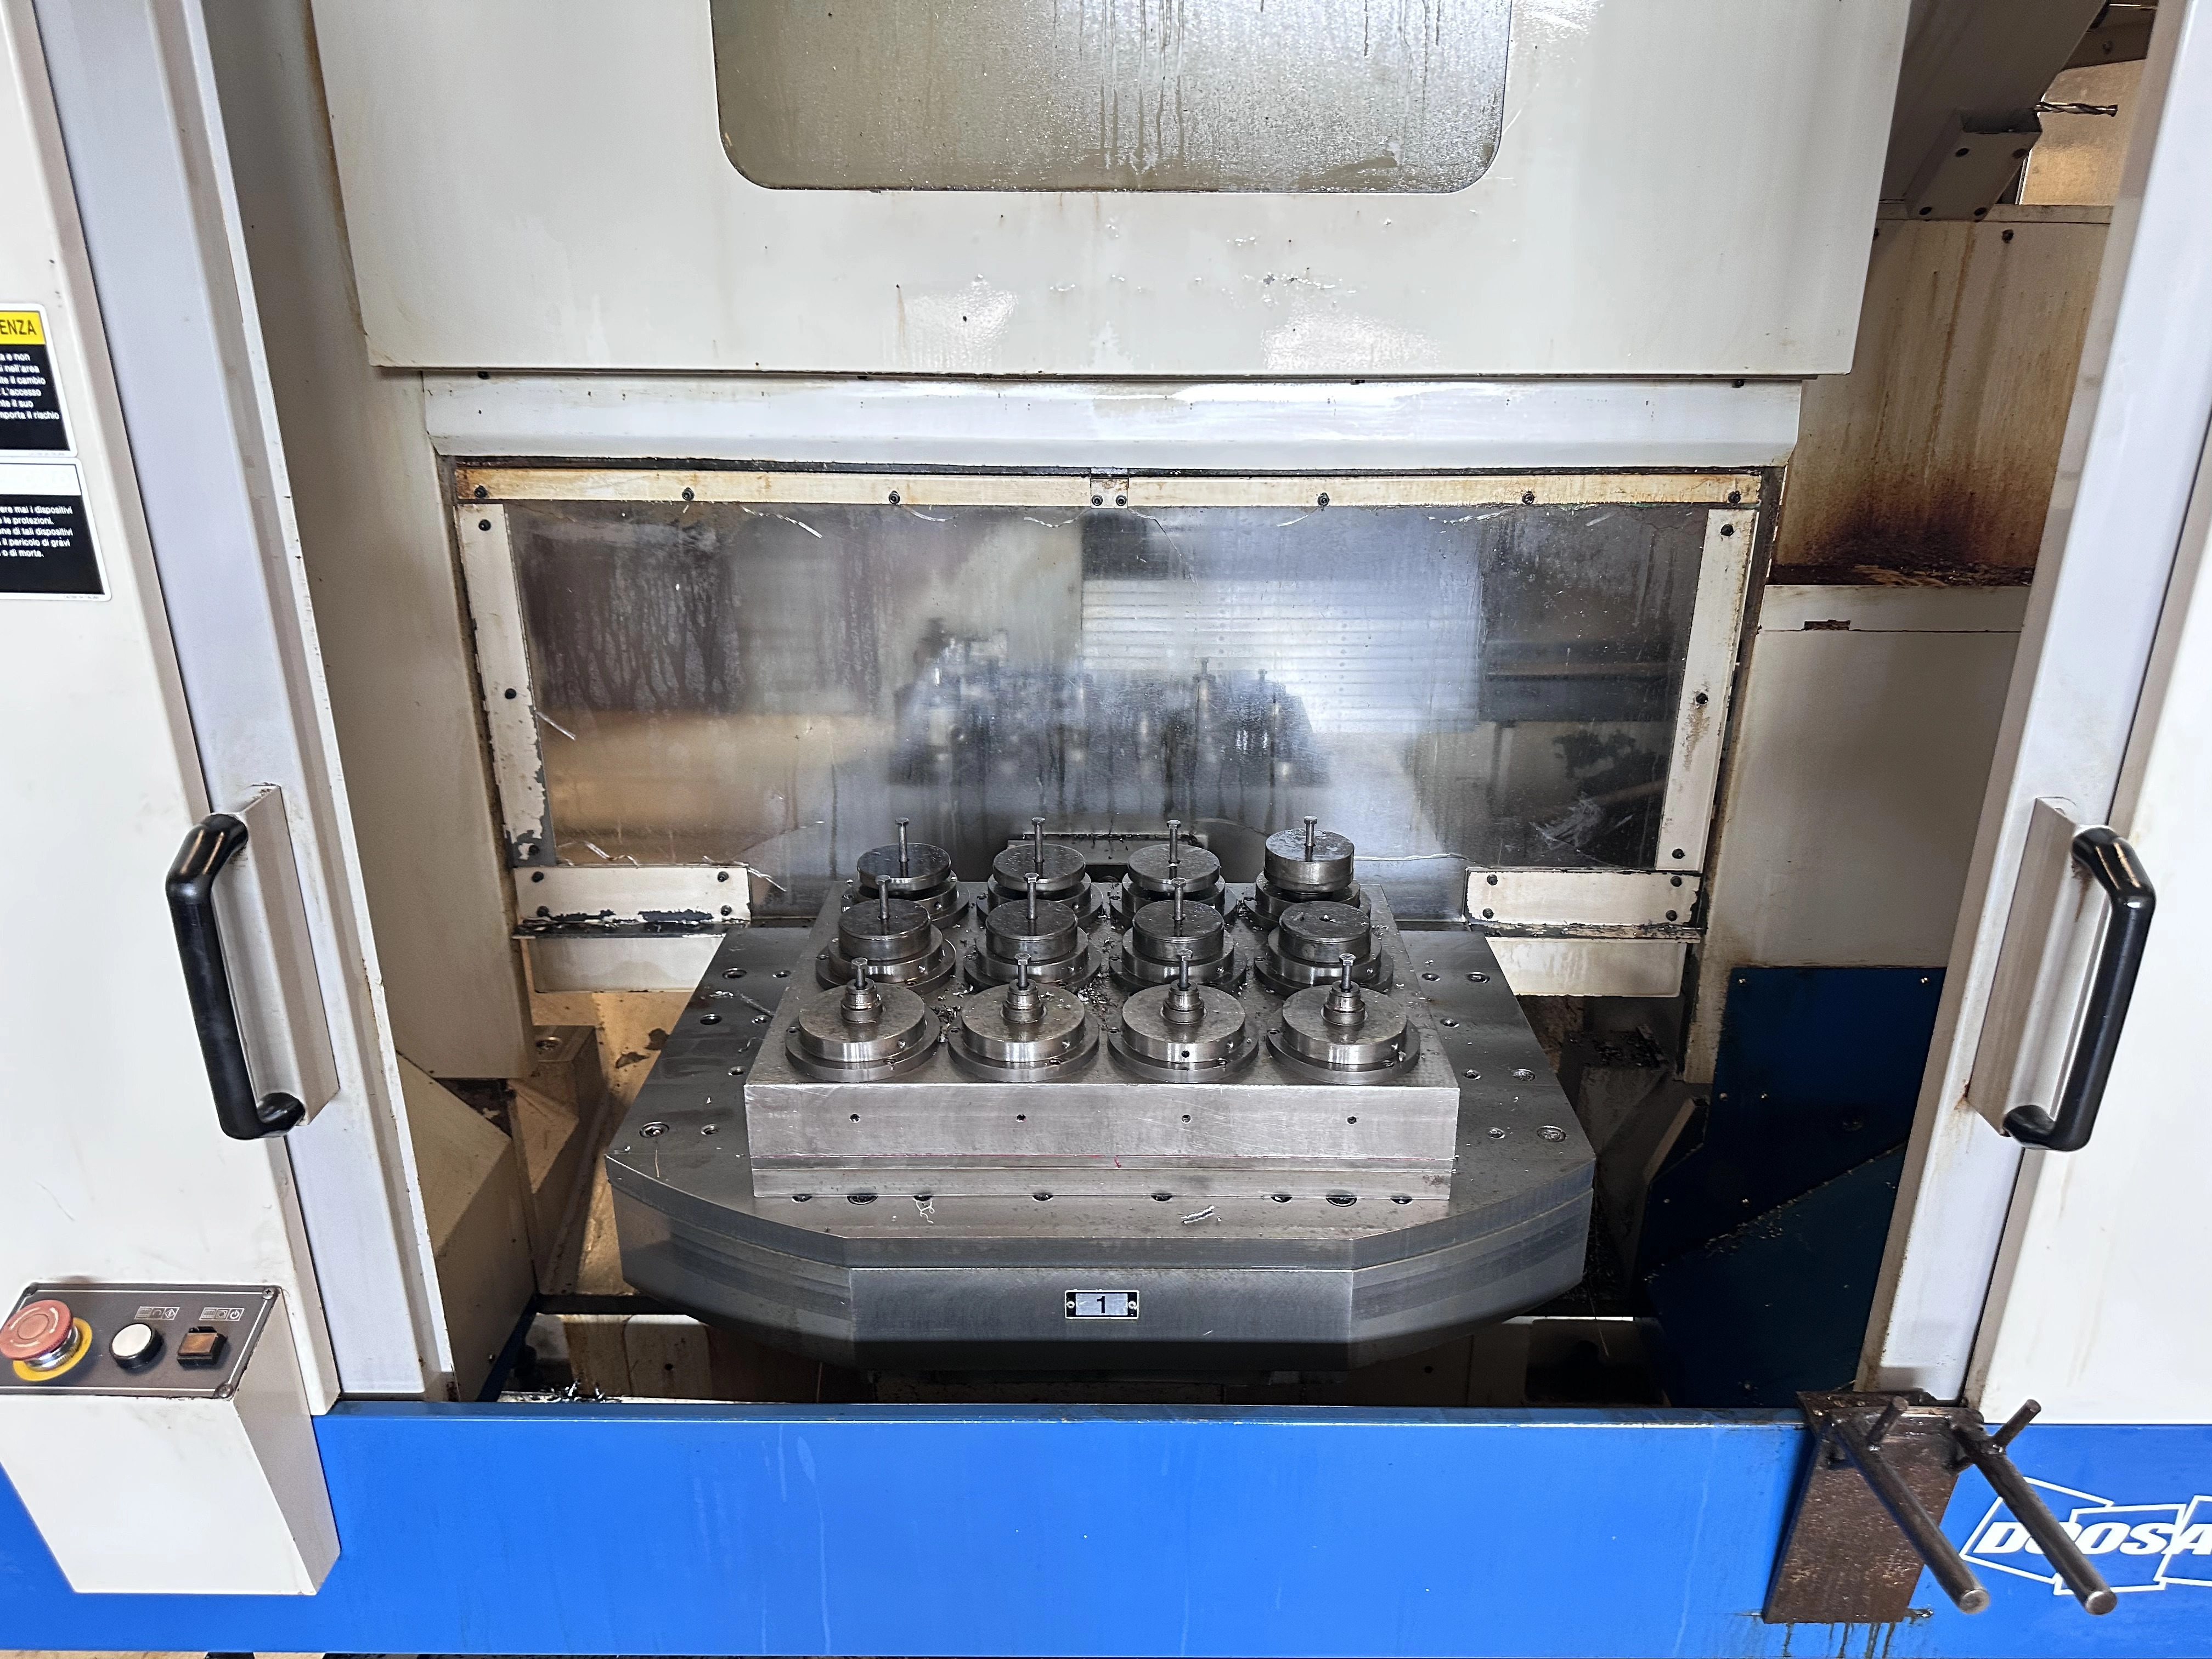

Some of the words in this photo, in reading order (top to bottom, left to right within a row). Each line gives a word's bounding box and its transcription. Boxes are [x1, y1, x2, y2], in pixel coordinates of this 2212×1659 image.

[4, 364, 40, 373] nell'area
[17, 376, 46, 385] cambio
[1, 387, 41, 396] L'accesso
[26, 410, 32, 419] il
[33, 411, 59, 419] rischio
[35, 506, 73, 515] dispositivi
[13, 517, 54, 525] protezioni.
[35, 528, 73, 537] dispositivi
[9, 538, 41, 546] pericolo
[50, 539, 71, 547] gravi
[1097, 1296, 1105, 1313] 1
[1973, 1521, 2212, 1555] DOSA
